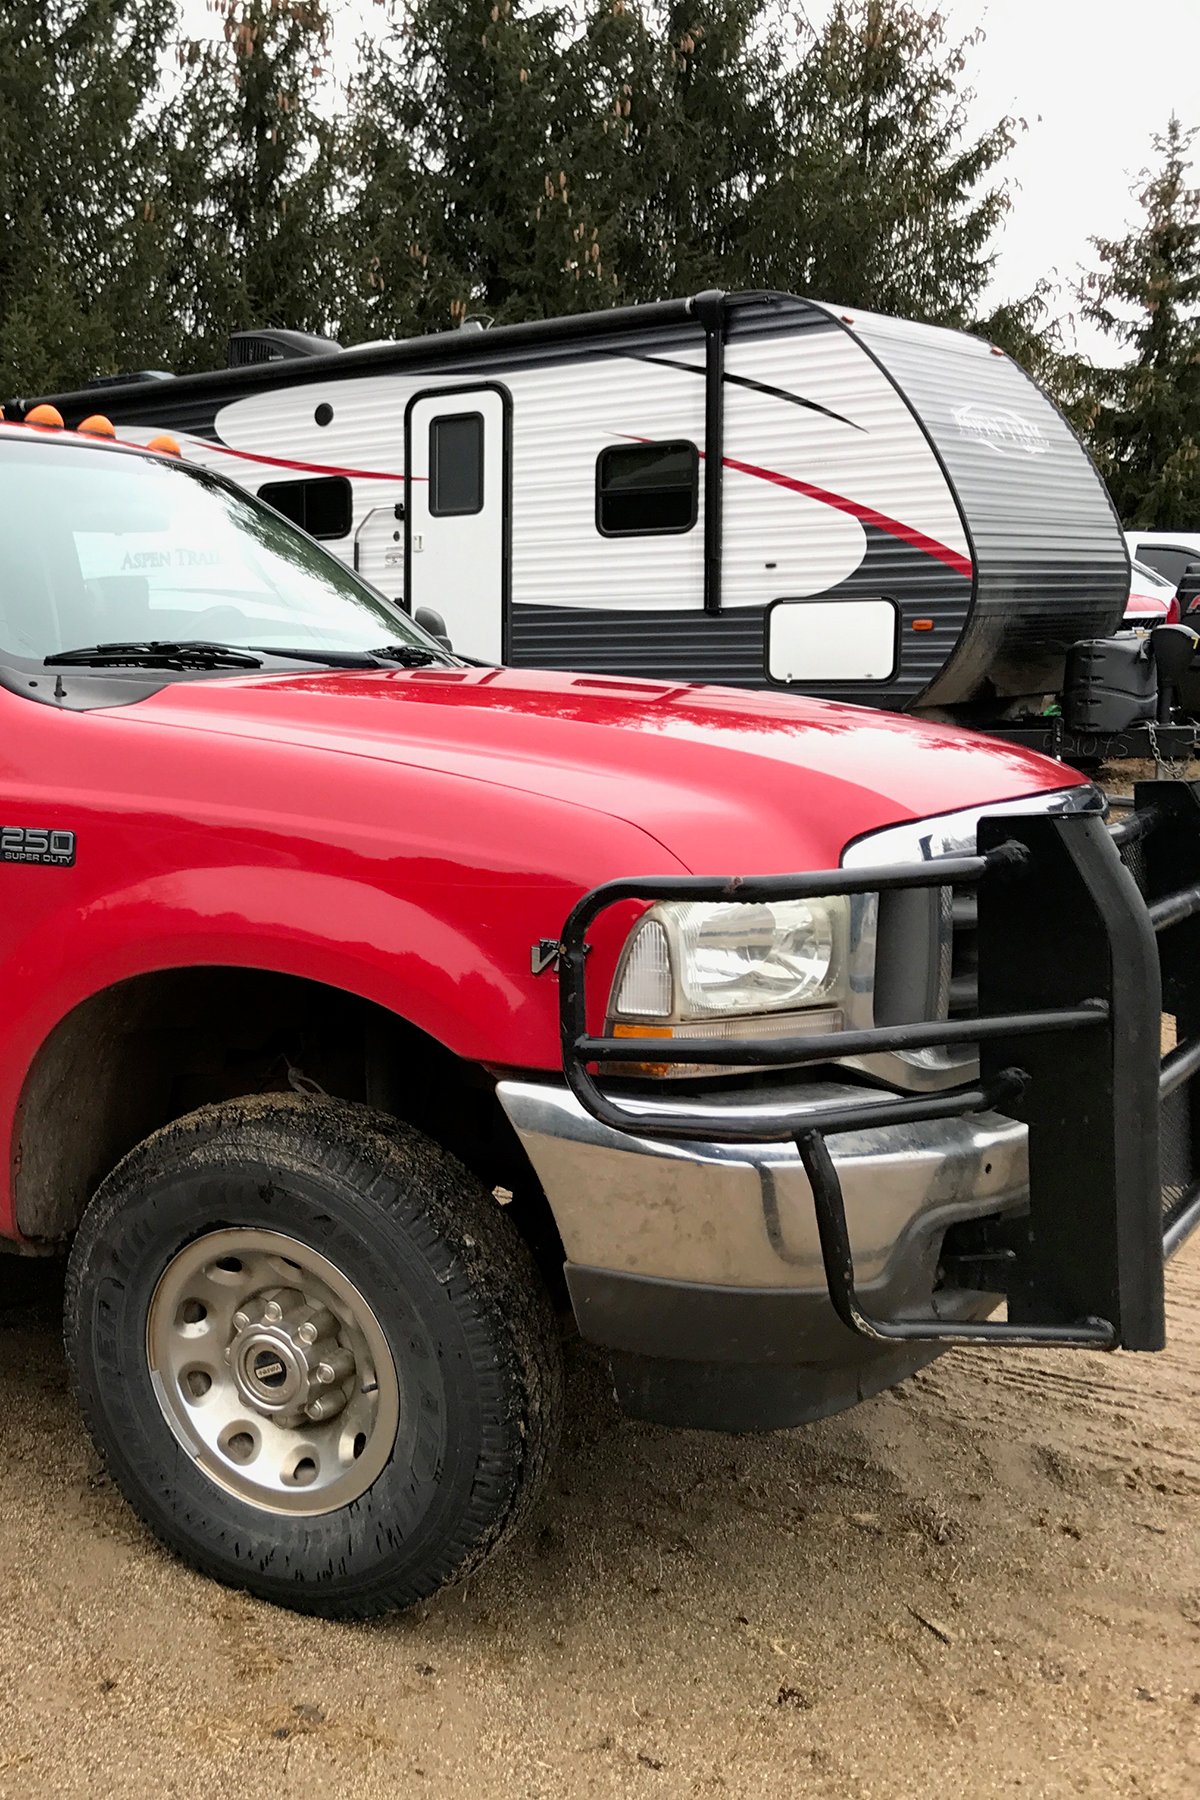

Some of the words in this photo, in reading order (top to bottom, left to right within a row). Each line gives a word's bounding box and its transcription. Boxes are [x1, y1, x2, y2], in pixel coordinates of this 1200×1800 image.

[120, 550, 171, 570] ASPEN
[4, 852, 40, 861] SUPER
[42, 854, 72, 864] DUTY
